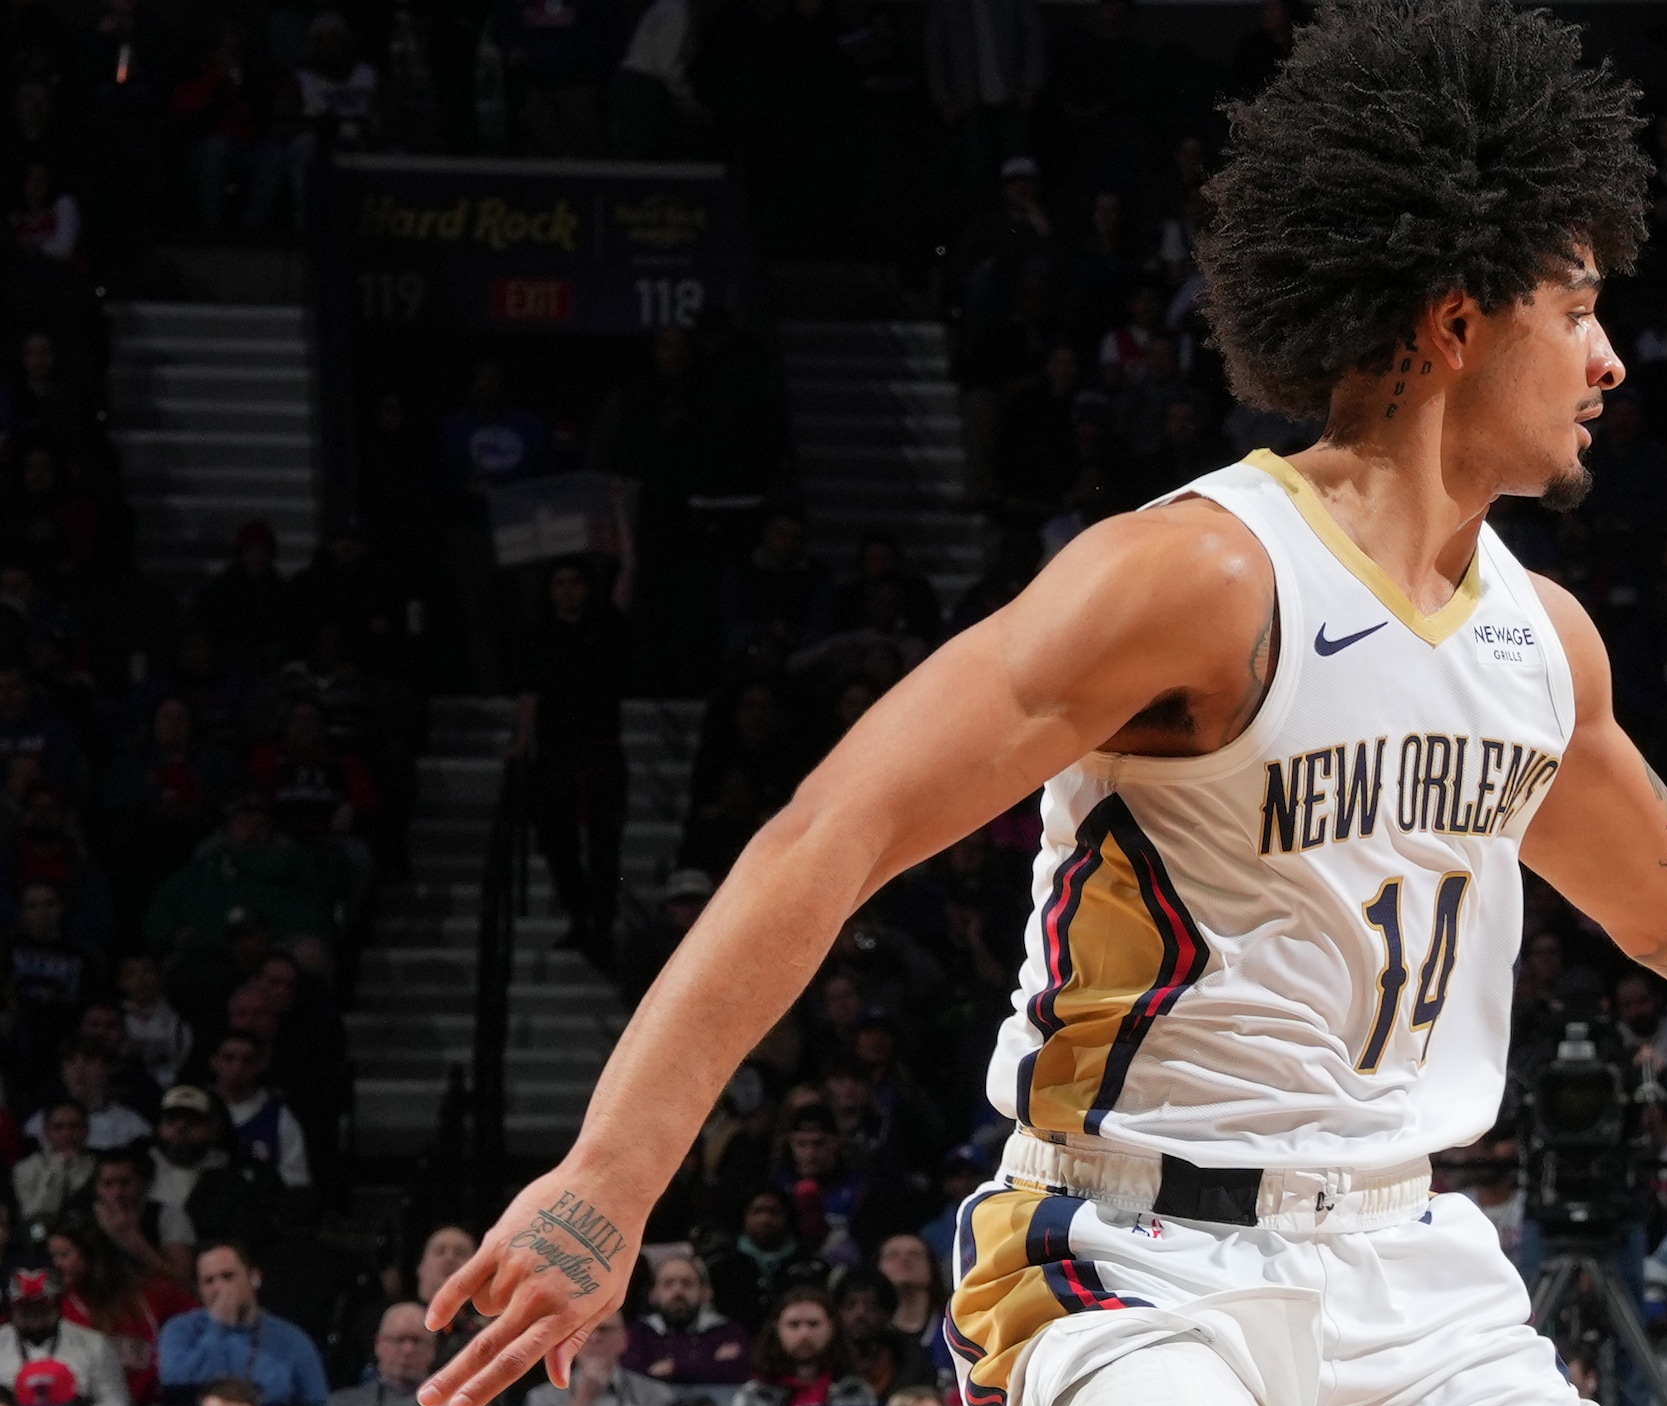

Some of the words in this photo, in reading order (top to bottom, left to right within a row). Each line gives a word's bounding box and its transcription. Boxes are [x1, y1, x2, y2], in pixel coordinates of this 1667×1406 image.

[360, 195, 468, 240] Hard
[472, 196, 581, 252] Rock
[356, 271, 425, 321] 119
[502, 279, 563, 321] EXIT
[634, 277, 705, 329] 118
[1473, 625, 1534, 646] NEWAGE
[1493, 649, 1523, 663] GRILLS
[1258, 735, 1388, 858] NEW
[1353, 869, 1472, 1075] 14
[548, 1189, 627, 1261] FAMILY
[508, 1216, 601, 1300] Everything
